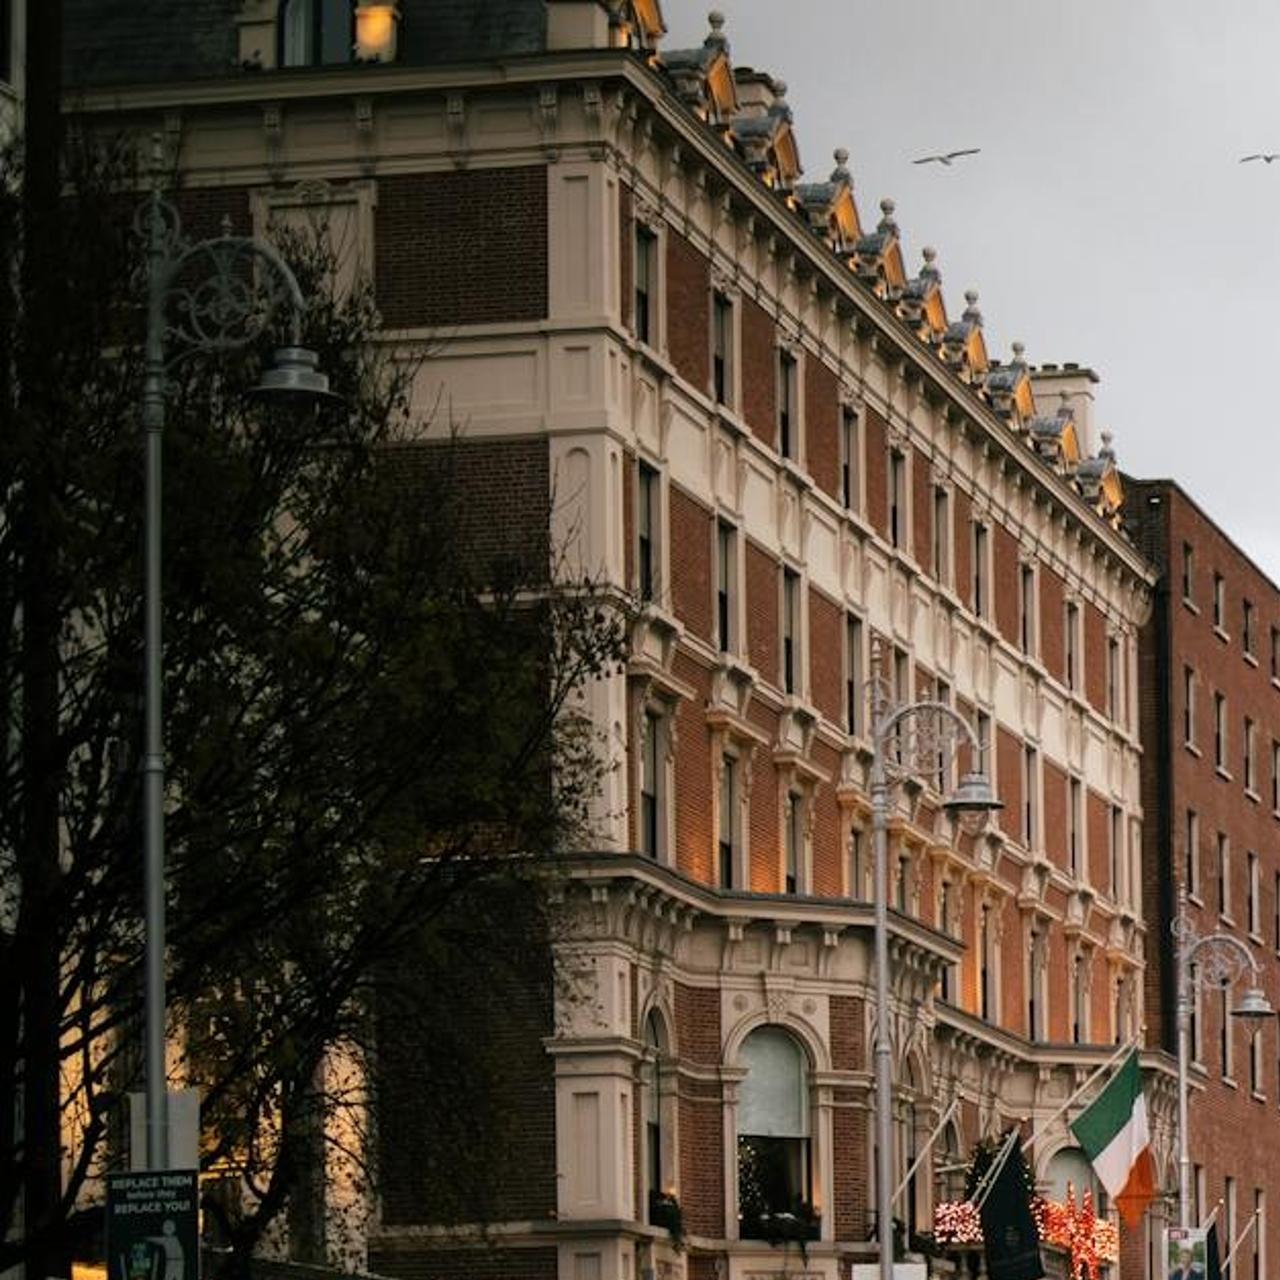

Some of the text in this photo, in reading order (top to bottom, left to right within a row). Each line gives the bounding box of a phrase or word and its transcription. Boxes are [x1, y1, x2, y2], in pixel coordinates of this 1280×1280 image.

[111, 1175, 193, 1190] REPLACE THEM
[113, 1203, 161, 1215] REPLACE
